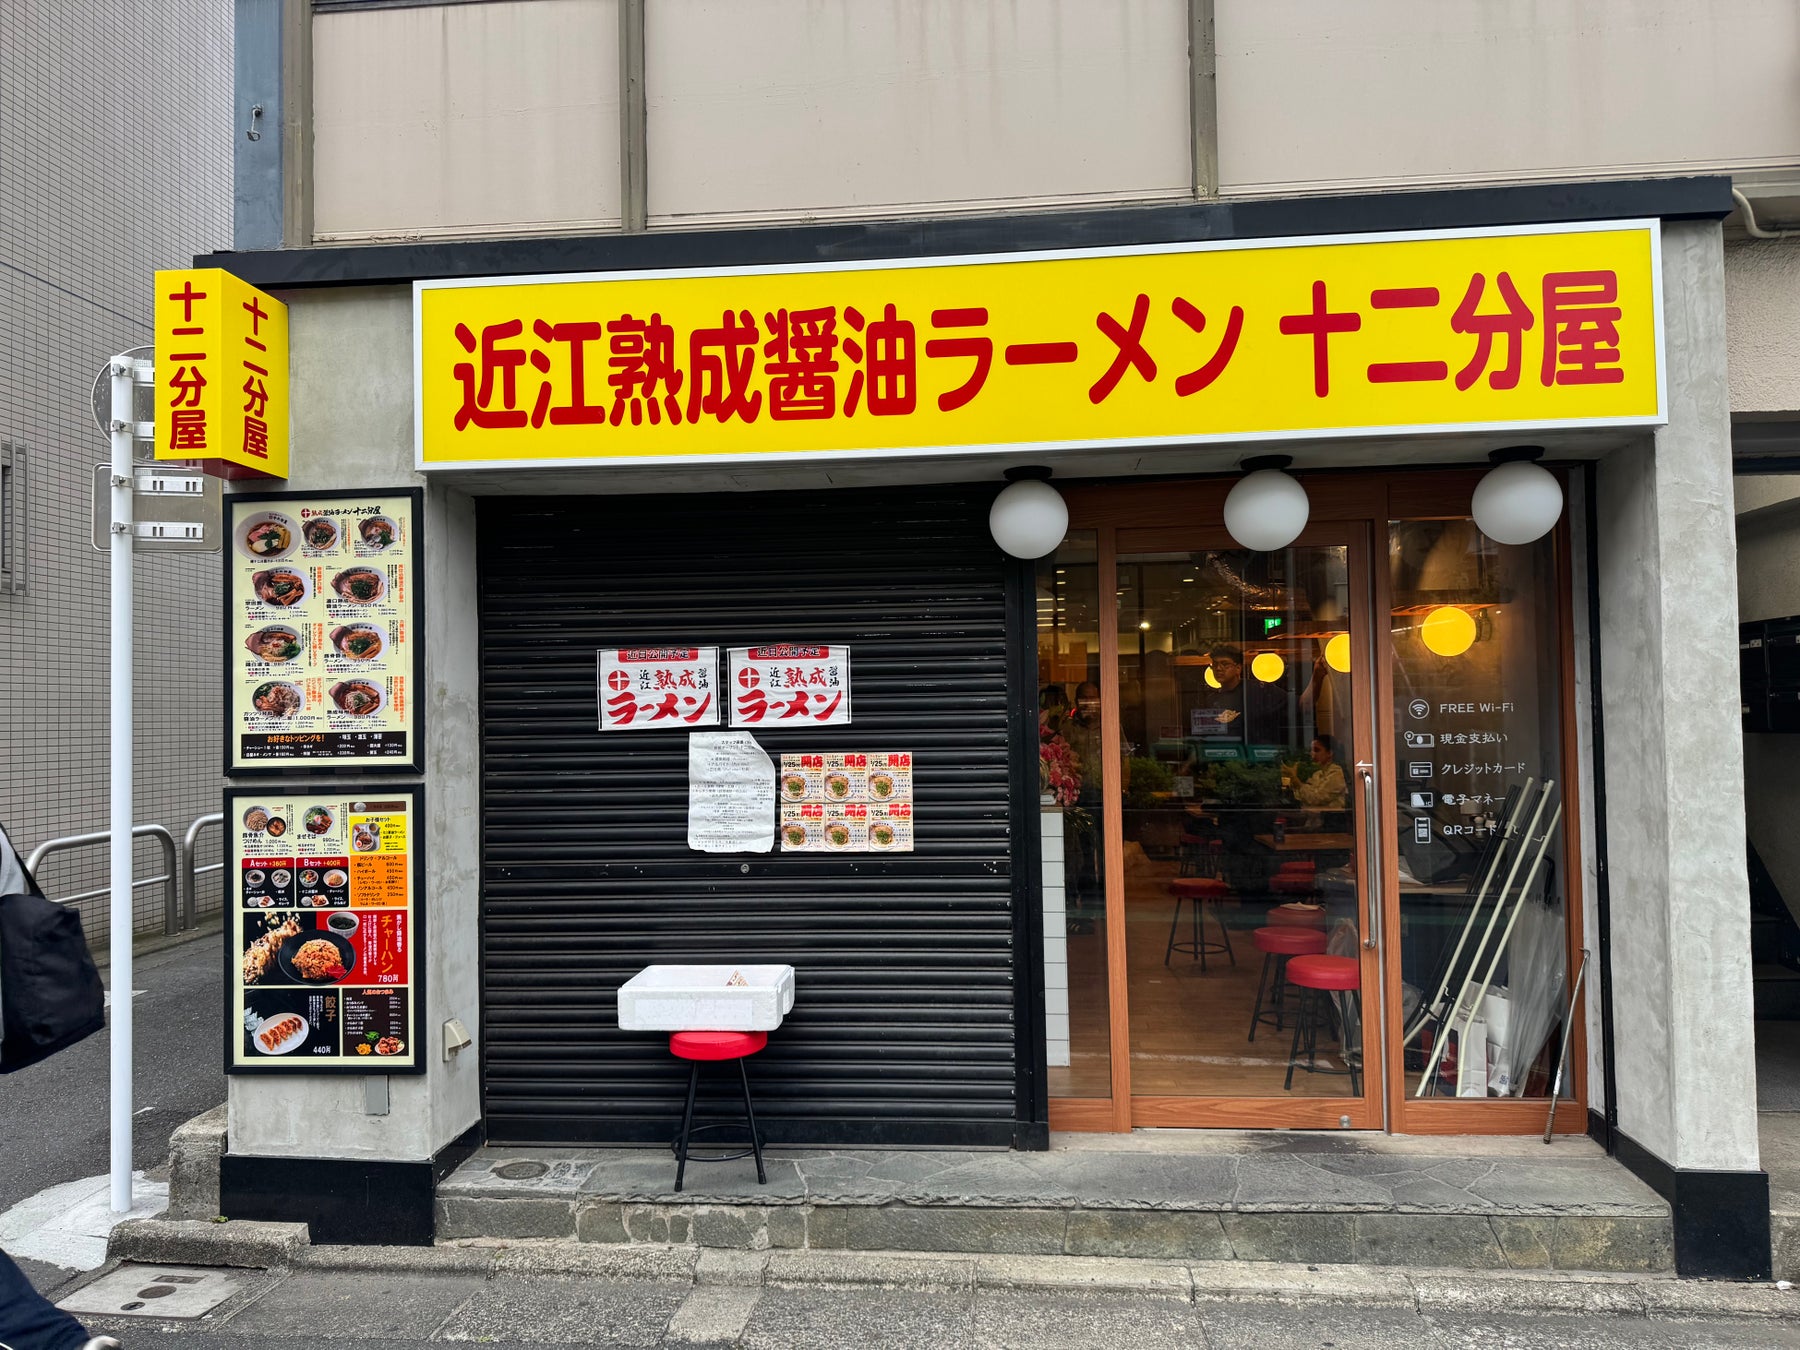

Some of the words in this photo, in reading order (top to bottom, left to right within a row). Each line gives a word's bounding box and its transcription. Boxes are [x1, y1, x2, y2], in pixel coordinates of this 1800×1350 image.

[453, 293, 1244, 432] 近江熟成醤油ラーメン
[1279, 269, 1625, 398] 十二分屋
[169, 281, 207, 450] 十二分屋
[242, 297, 269, 460] 十二分屋
[627, 649, 689, 660] 近日公開予定
[757, 646, 821, 657] 近日公開予定
[639, 669, 651, 690] 近江
[653, 669, 697, 691] 熟成
[698, 667, 709, 689] 醤油
[769, 666, 781, 688] 近江
[784, 666, 828, 690] 熟成
[829, 665, 840, 688] 醤油
[607, 691, 711, 725] ラーメン
[737, 689, 842, 723] ラーメン
[1440, 703, 1475, 714] FREE
[1479, 702, 1514, 713] Wi-Fi
[1440, 732, 1508, 745] 現金支払い
[801, 755, 823, 768] 開店
[844, 754, 867, 767] 開店
[888, 754, 911, 767] 開店
[1441, 762, 1526, 776] クレジットカード
[1442, 793, 1506, 805] 電子マネー
[801, 804, 823, 817] 開店
[844, 804, 867, 817] 開店
[889, 804, 911, 817] 開店
[1443, 825, 1498, 836] QRコード
[381, 915, 394, 973] チャーハン
[378, 974, 399, 982] 780円
[325, 995, 337, 1022] 餃子
[313, 1045, 331, 1053] 440円
